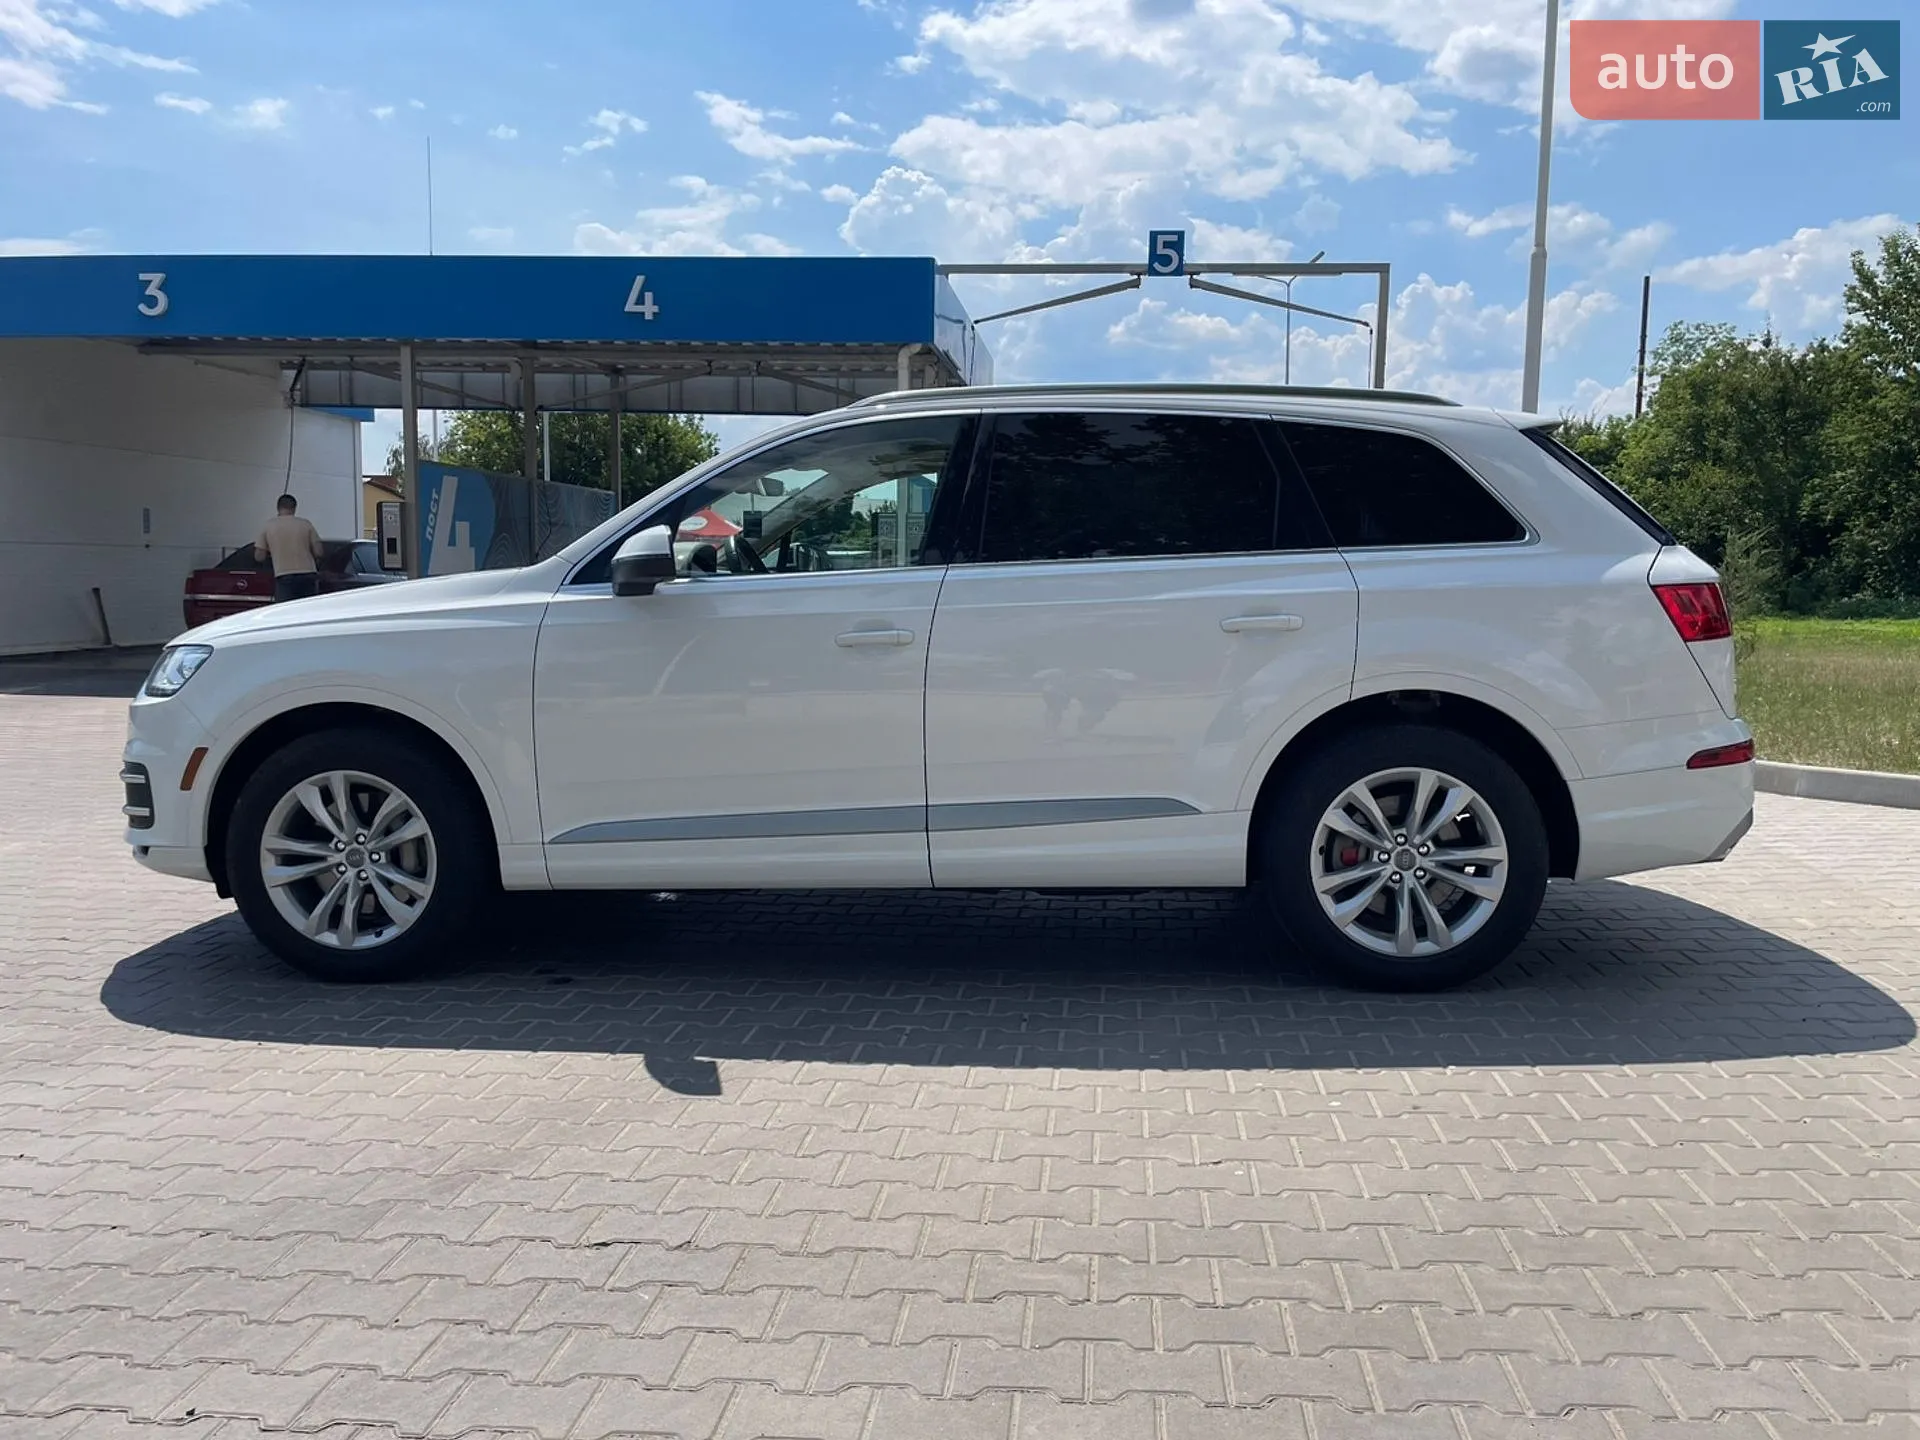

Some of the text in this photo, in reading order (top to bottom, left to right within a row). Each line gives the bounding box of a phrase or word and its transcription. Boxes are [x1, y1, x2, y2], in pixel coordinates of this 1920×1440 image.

[1152, 234, 1180, 274] 5
[137, 272, 169, 317] 3
[623, 274, 660, 321] 4
[427, 475, 476, 575] 4
